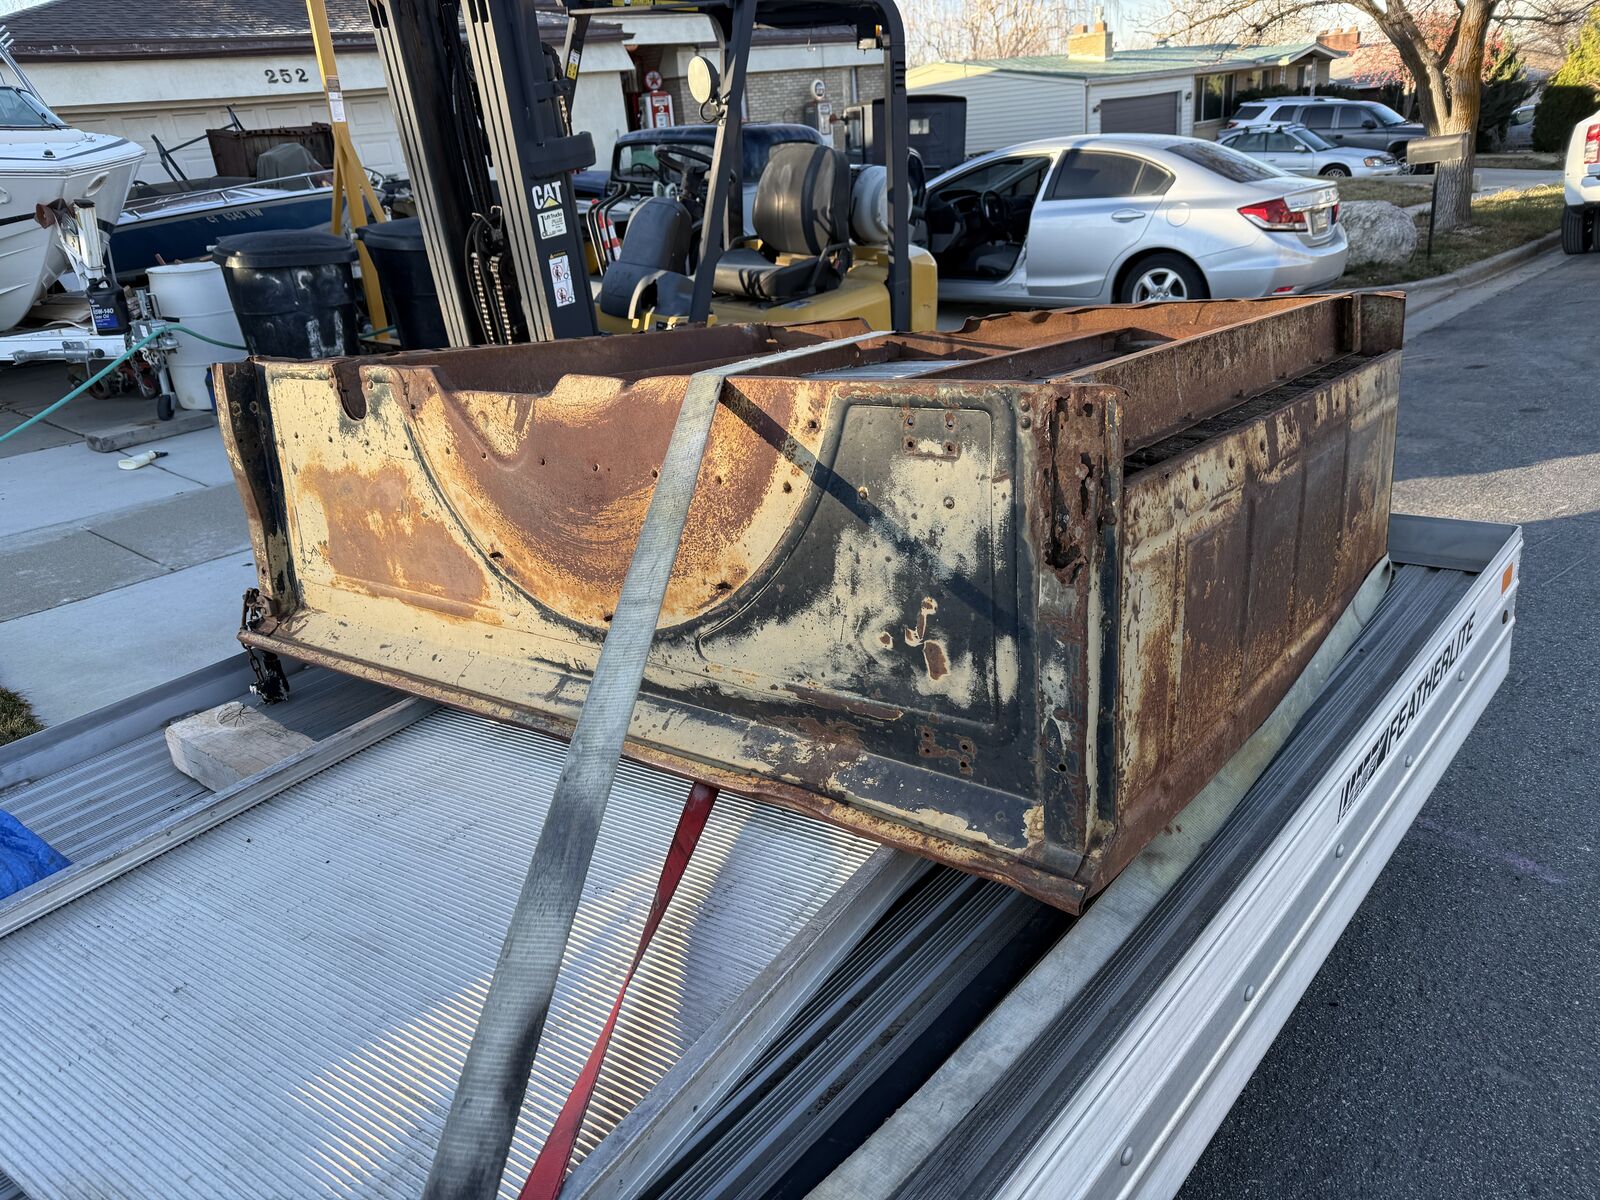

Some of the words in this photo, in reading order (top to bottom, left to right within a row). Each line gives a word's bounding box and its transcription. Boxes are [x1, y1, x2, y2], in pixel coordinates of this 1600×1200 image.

[264, 67, 309, 84] 252
[531, 180, 562, 210] CAT
[1387, 609, 1476, 755] FEATHERLITE
